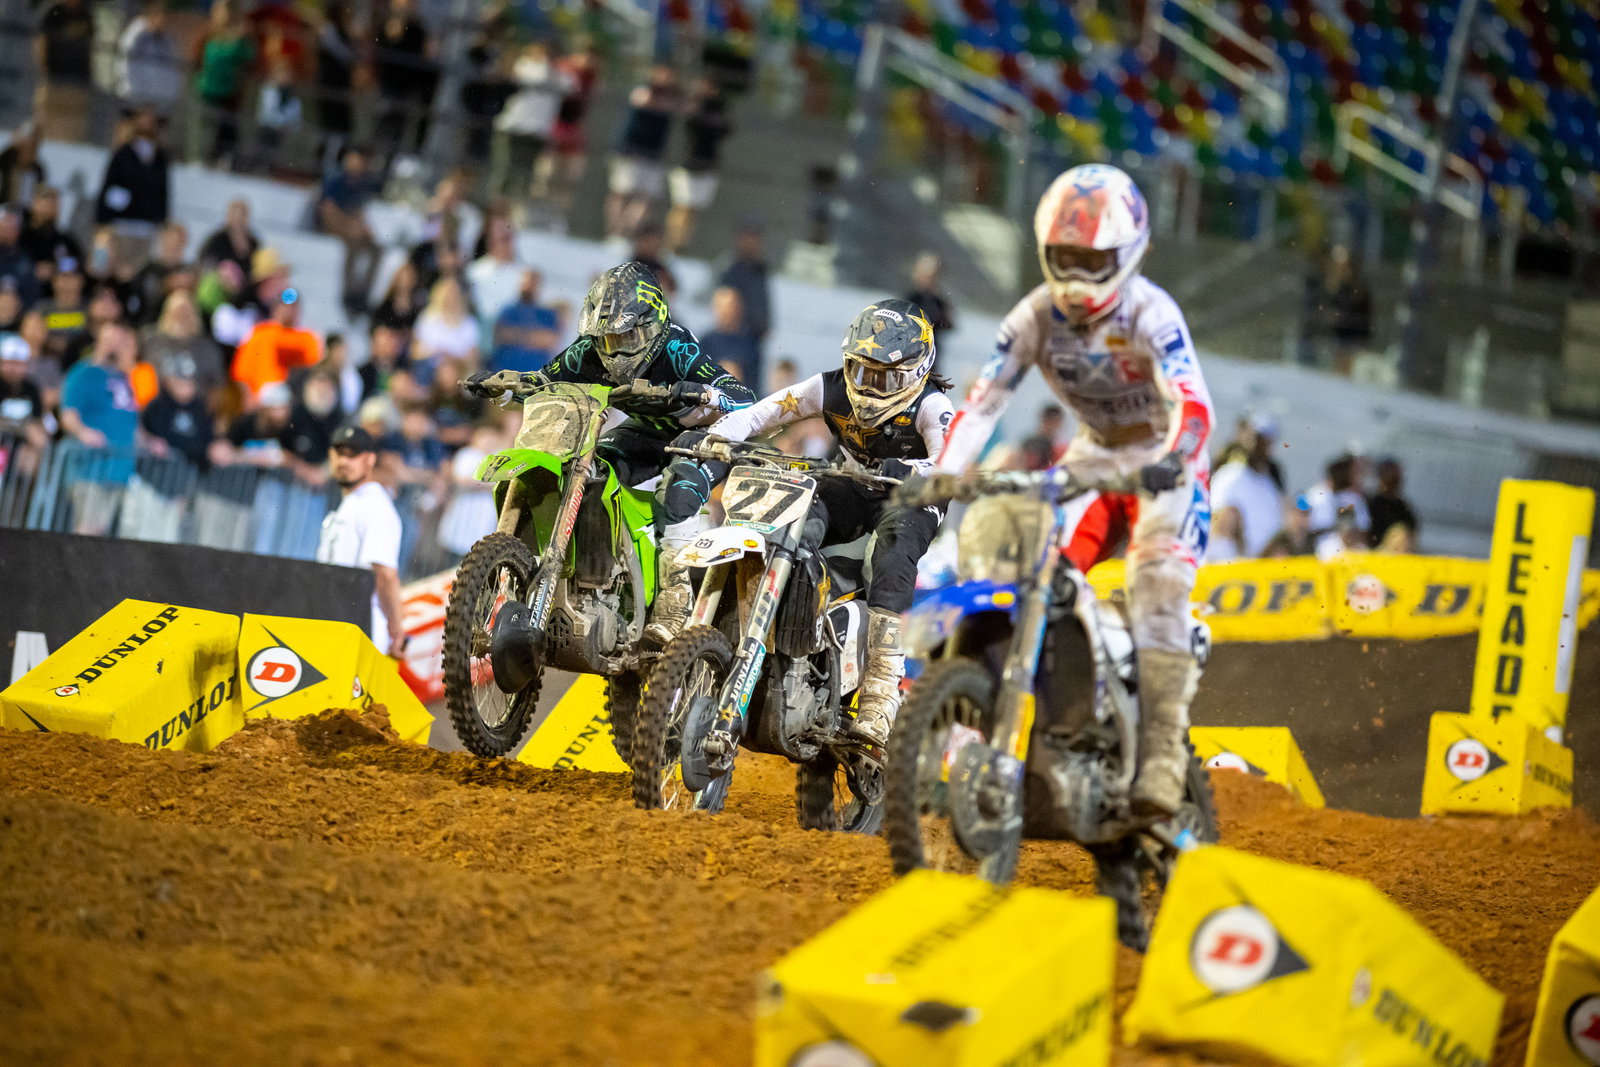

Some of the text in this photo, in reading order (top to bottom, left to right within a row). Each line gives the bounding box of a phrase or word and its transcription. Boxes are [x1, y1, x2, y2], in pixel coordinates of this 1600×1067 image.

[727, 479, 806, 525] 27
[75, 607, 179, 684] DUNLOP
[254, 661, 297, 683] D
[745, 648, 766, 695] MOTOREX
[1207, 933, 1265, 966] D
